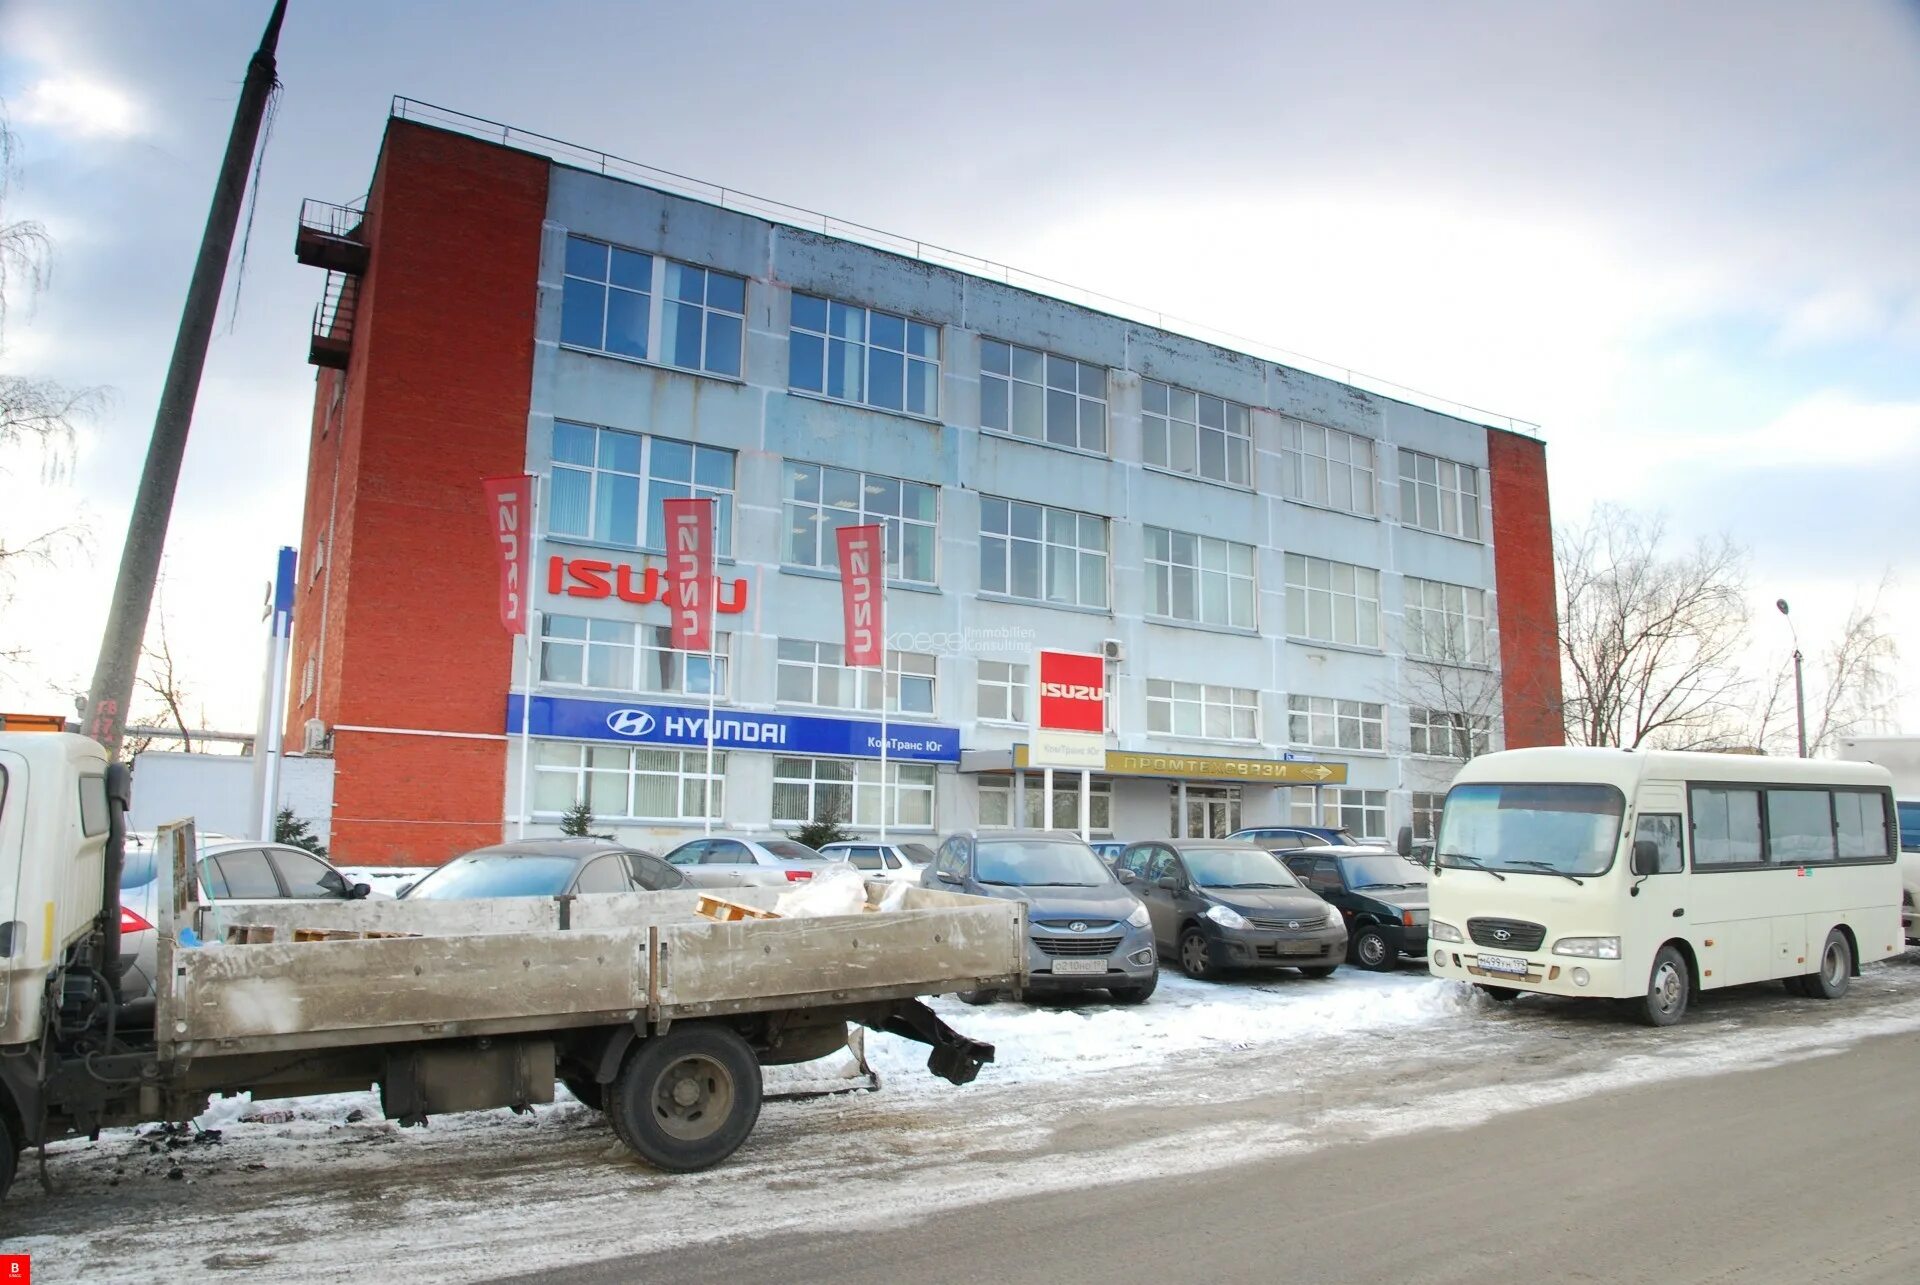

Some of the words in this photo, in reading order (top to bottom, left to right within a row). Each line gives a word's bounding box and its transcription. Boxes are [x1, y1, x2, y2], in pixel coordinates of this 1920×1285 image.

[548, 555, 748, 614] ISUU
[1041, 682, 1103, 701] ISUZU
[665, 715, 787, 744] HYUNDAI
[926, 740, 943, 752] Юг
